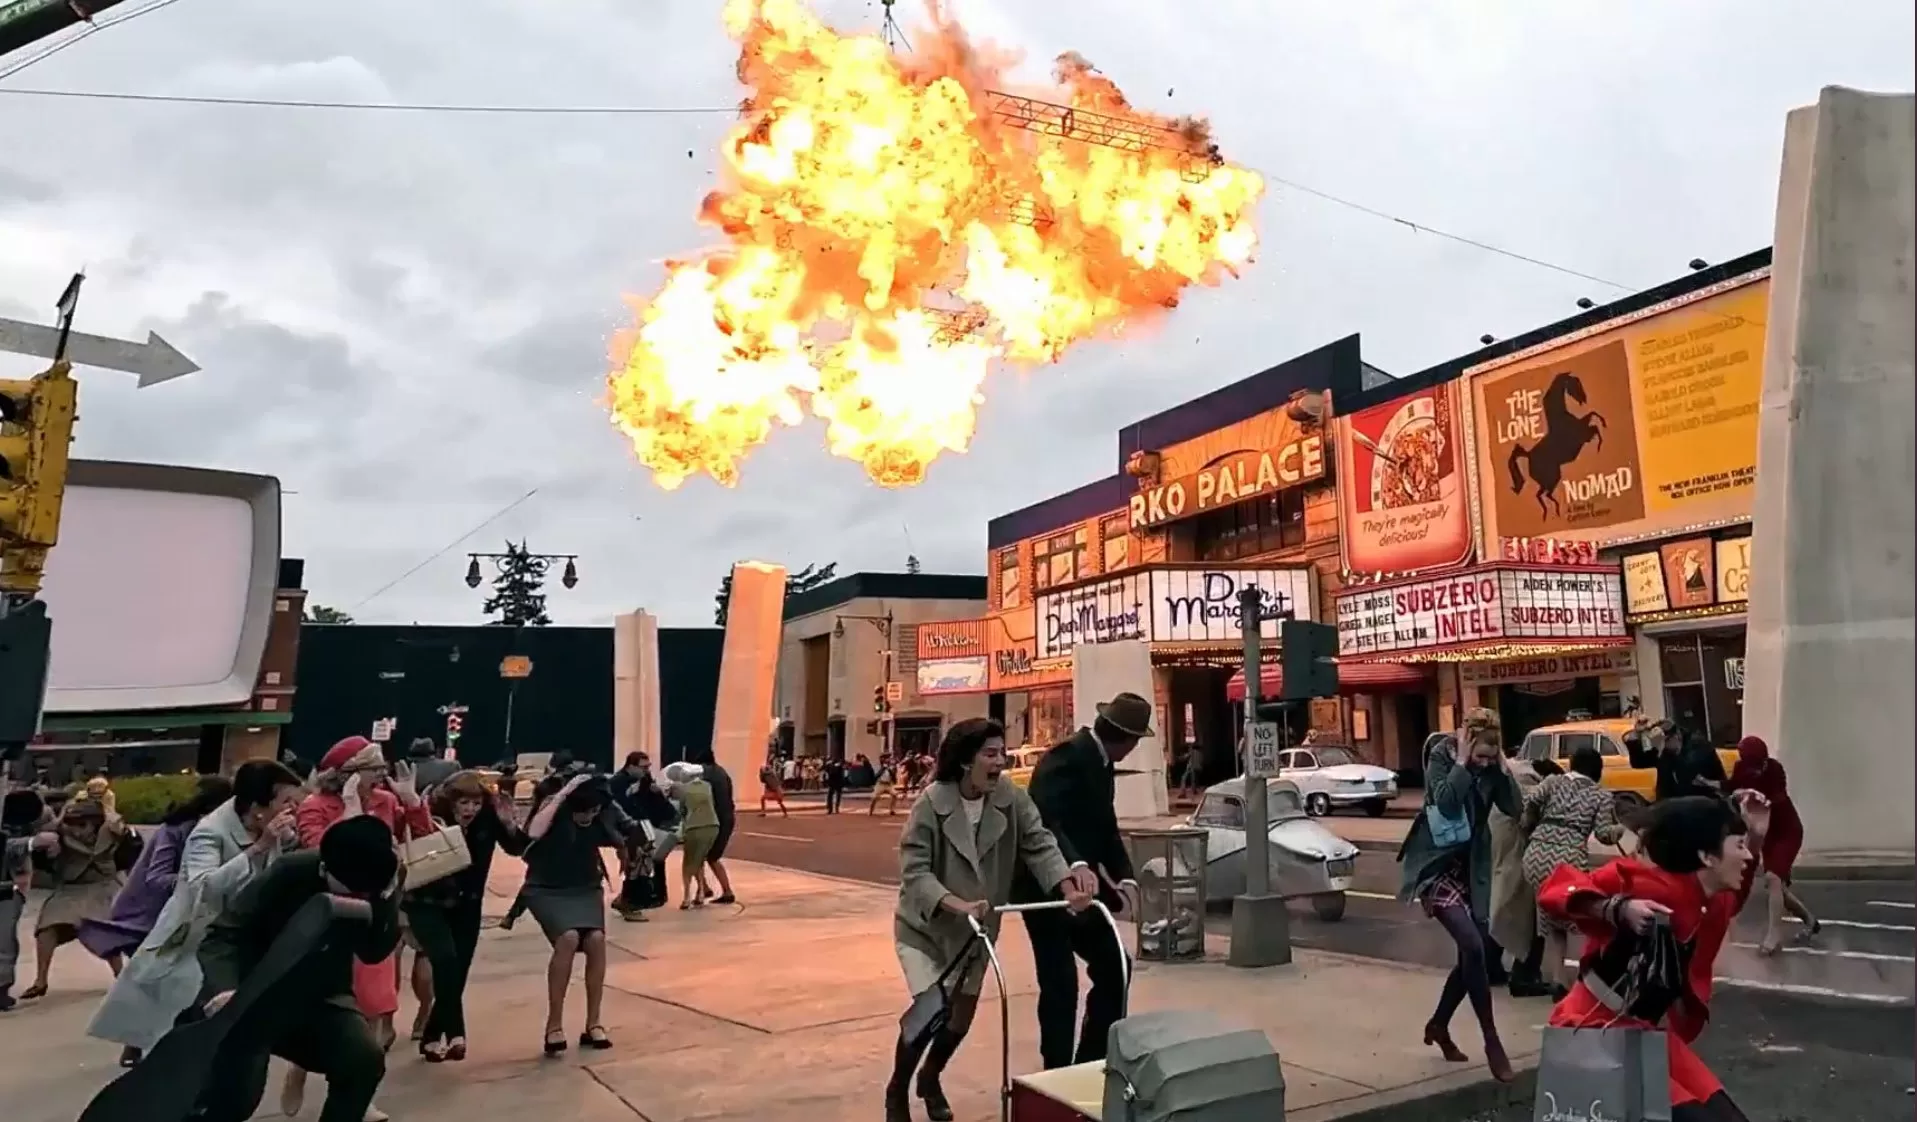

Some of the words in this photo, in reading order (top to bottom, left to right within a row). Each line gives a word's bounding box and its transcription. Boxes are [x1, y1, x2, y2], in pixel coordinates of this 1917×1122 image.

[1506, 389, 1542, 419] THE
[1497, 415, 1545, 443] LONE
[1130, 482, 1186, 529] RKO
[1197, 436, 1323, 509] PALACE
[1562, 467, 1632, 503] NOMAD
[1731, 465, 1757, 478] THEAT
[1362, 514, 1397, 534] They're
[1400, 504, 1450, 526] magically
[1379, 524, 1429, 547] delicious!
[1501, 537, 1599, 564] EMBASSY
[1204, 572, 1273, 602] Der
[1396, 578, 1495, 616] SUBZERO
[1557, 580, 1604, 593] POWER'S
[1077, 602, 1144, 633] Margaret
[1166, 590, 1290, 629] Margret
[1338, 601, 1360, 615] LYLE
[1364, 595, 1390, 610] MOSS
[1511, 607, 1574, 624] SUBZERO
[1578, 607, 1618, 625] INTEL
[1339, 619, 1362, 632] GREG
[1435, 608, 1498, 639] INTEL
[1490, 658, 1558, 679] SUBZERO
[1564, 652, 1613, 673] INTEL
[1254, 758, 1275, 772] TURN
